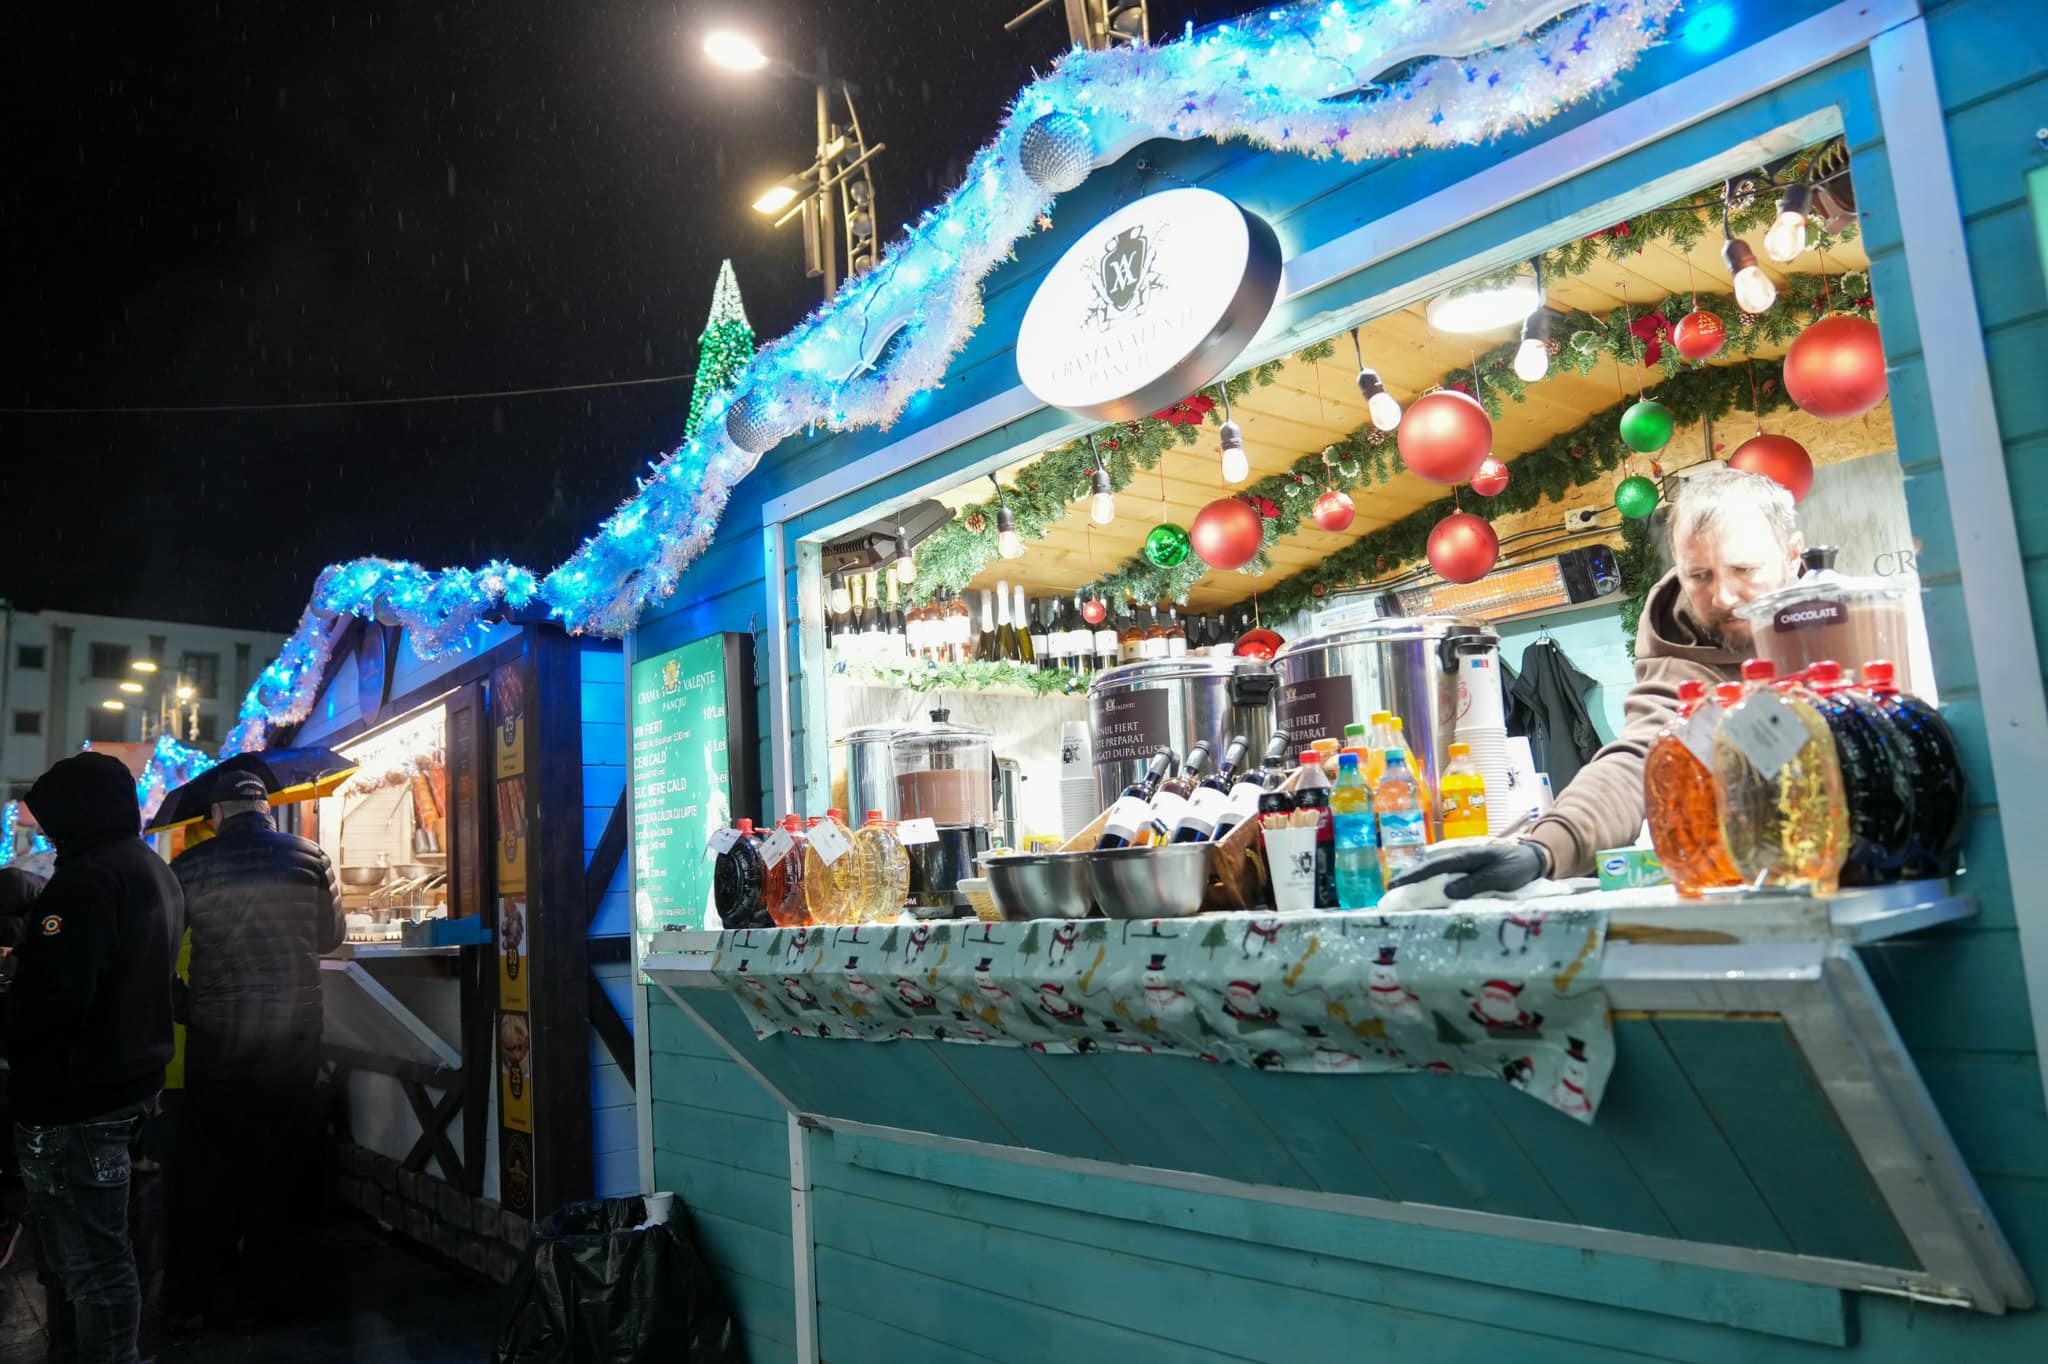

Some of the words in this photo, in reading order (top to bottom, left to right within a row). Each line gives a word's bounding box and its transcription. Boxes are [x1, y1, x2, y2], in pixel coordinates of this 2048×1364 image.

[1780, 607, 1838, 624] CHOCOLATE
[683, 670, 716, 690] VALENTE
[1114, 721, 1140, 733] FIERT
[1296, 713, 1321, 727] FIERT
[1105, 733, 1145, 748] PREPARAT
[1290, 726, 1328, 741] REPARAT
[667, 777, 687, 793] CALD
